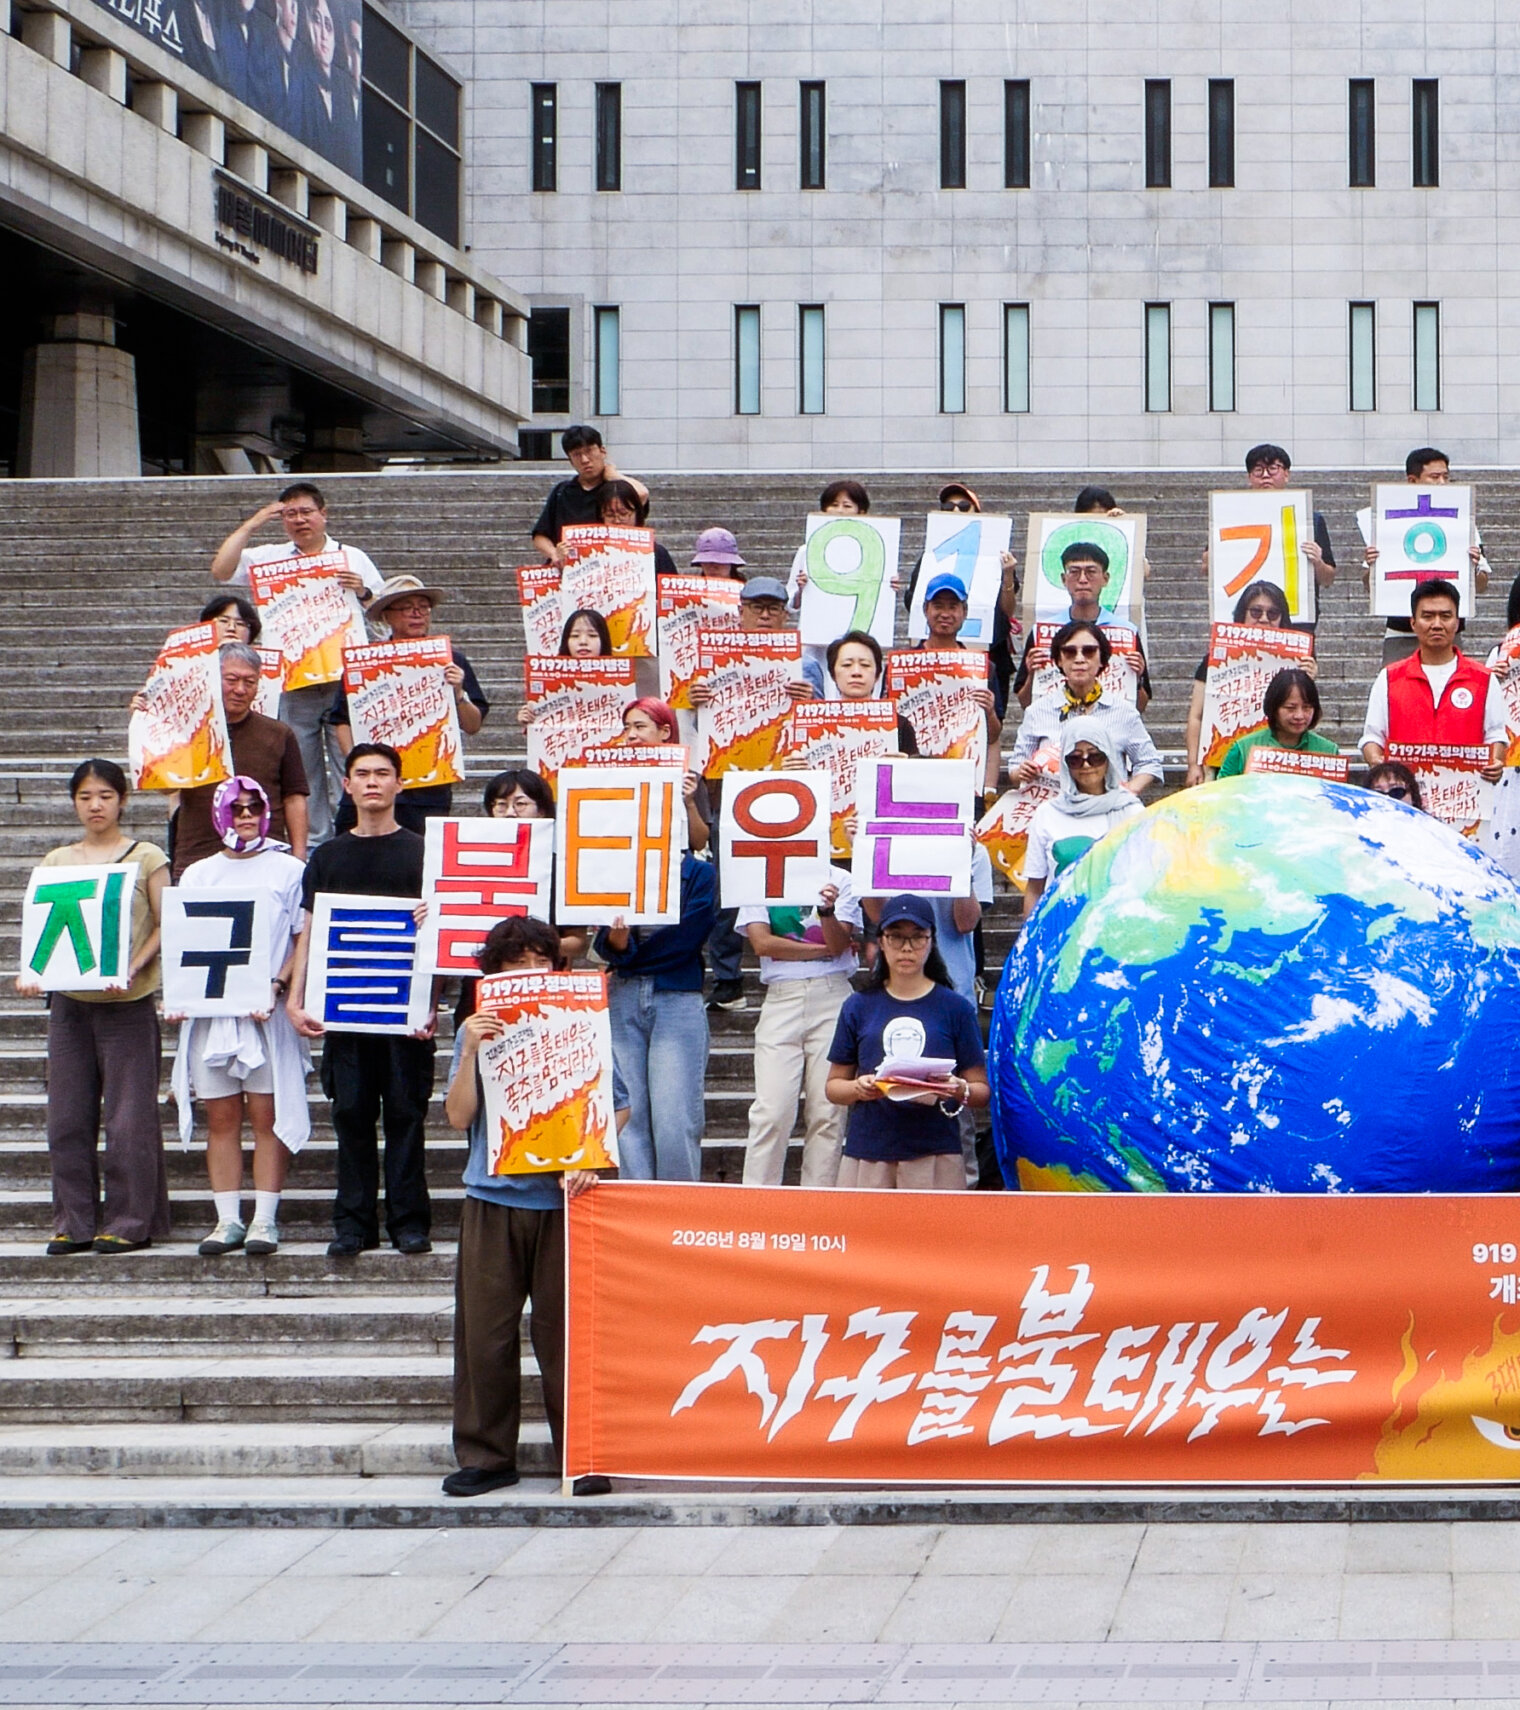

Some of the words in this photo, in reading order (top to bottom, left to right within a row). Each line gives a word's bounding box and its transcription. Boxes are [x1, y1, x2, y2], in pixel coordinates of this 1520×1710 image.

[807, 519, 886, 633] 9
[1220, 504, 1300, 616] 기
[1384, 494, 1460, 588] 후
[565, 781, 673, 914] 태
[731, 778, 818, 898] 우
[865, 764, 965, 891] 는
[29, 872, 128, 977] 지
[180, 900, 255, 999] 구
[434, 822, 538, 969] 불
[324, 908, 417, 1025] 를
[672, 1230, 734, 1250] 2026년
[738, 1232, 766, 1251] 8월
[770, 1232, 807, 1252] 19일
[811, 1234, 847, 1254] 10시
[1472, 1243, 1517, 1264] 919
